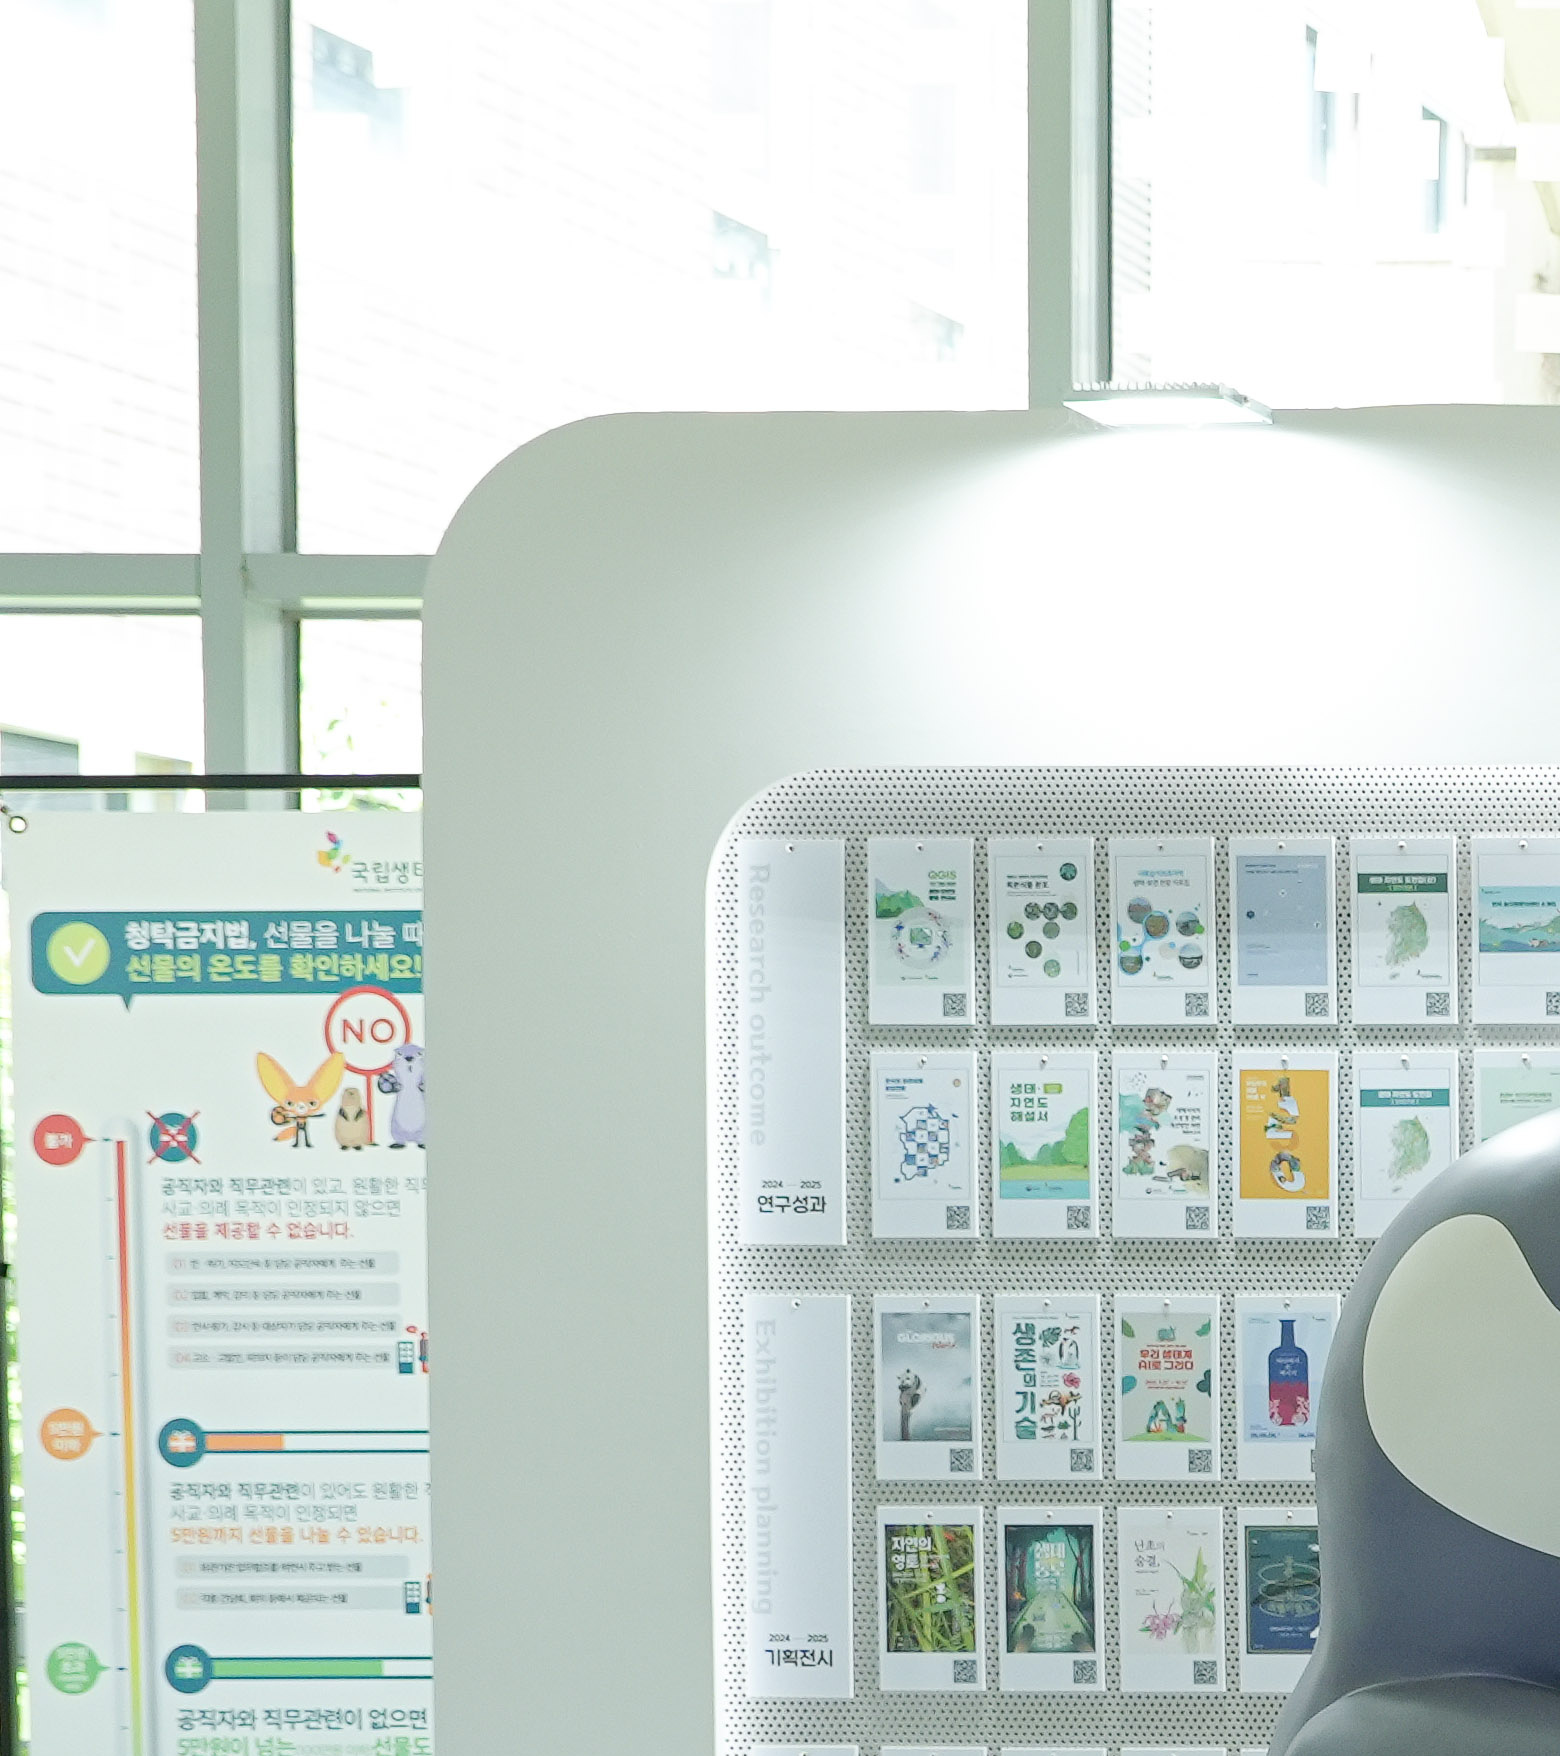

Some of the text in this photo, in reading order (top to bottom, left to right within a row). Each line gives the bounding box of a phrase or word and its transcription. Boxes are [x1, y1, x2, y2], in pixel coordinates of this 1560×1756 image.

[125, 920, 258, 951] 청탁금지법,
[263, 920, 340, 951] 선물을
[345, 920, 396, 951] 나눌
[126, 953, 423, 982] 선물의 온도를 확인하세요!
[750, 863, 773, 1147] Research outcome
[342, 1019, 395, 1044] NO
[762, 1181, 822, 1189] 2024 2025
[758, 1195, 828, 1214] 연구성과
[267, 1221, 282, 1240] 수
[752, 1318, 778, 1615] Exhibition planning
[891, 1536, 932, 1552] 자연의
[769, 1634, 829, 1643] 2024 2025
[765, 1648, 833, 1668] 기획전시
[177, 1708, 428, 1730] 공직자와 직무관련이 없으면
